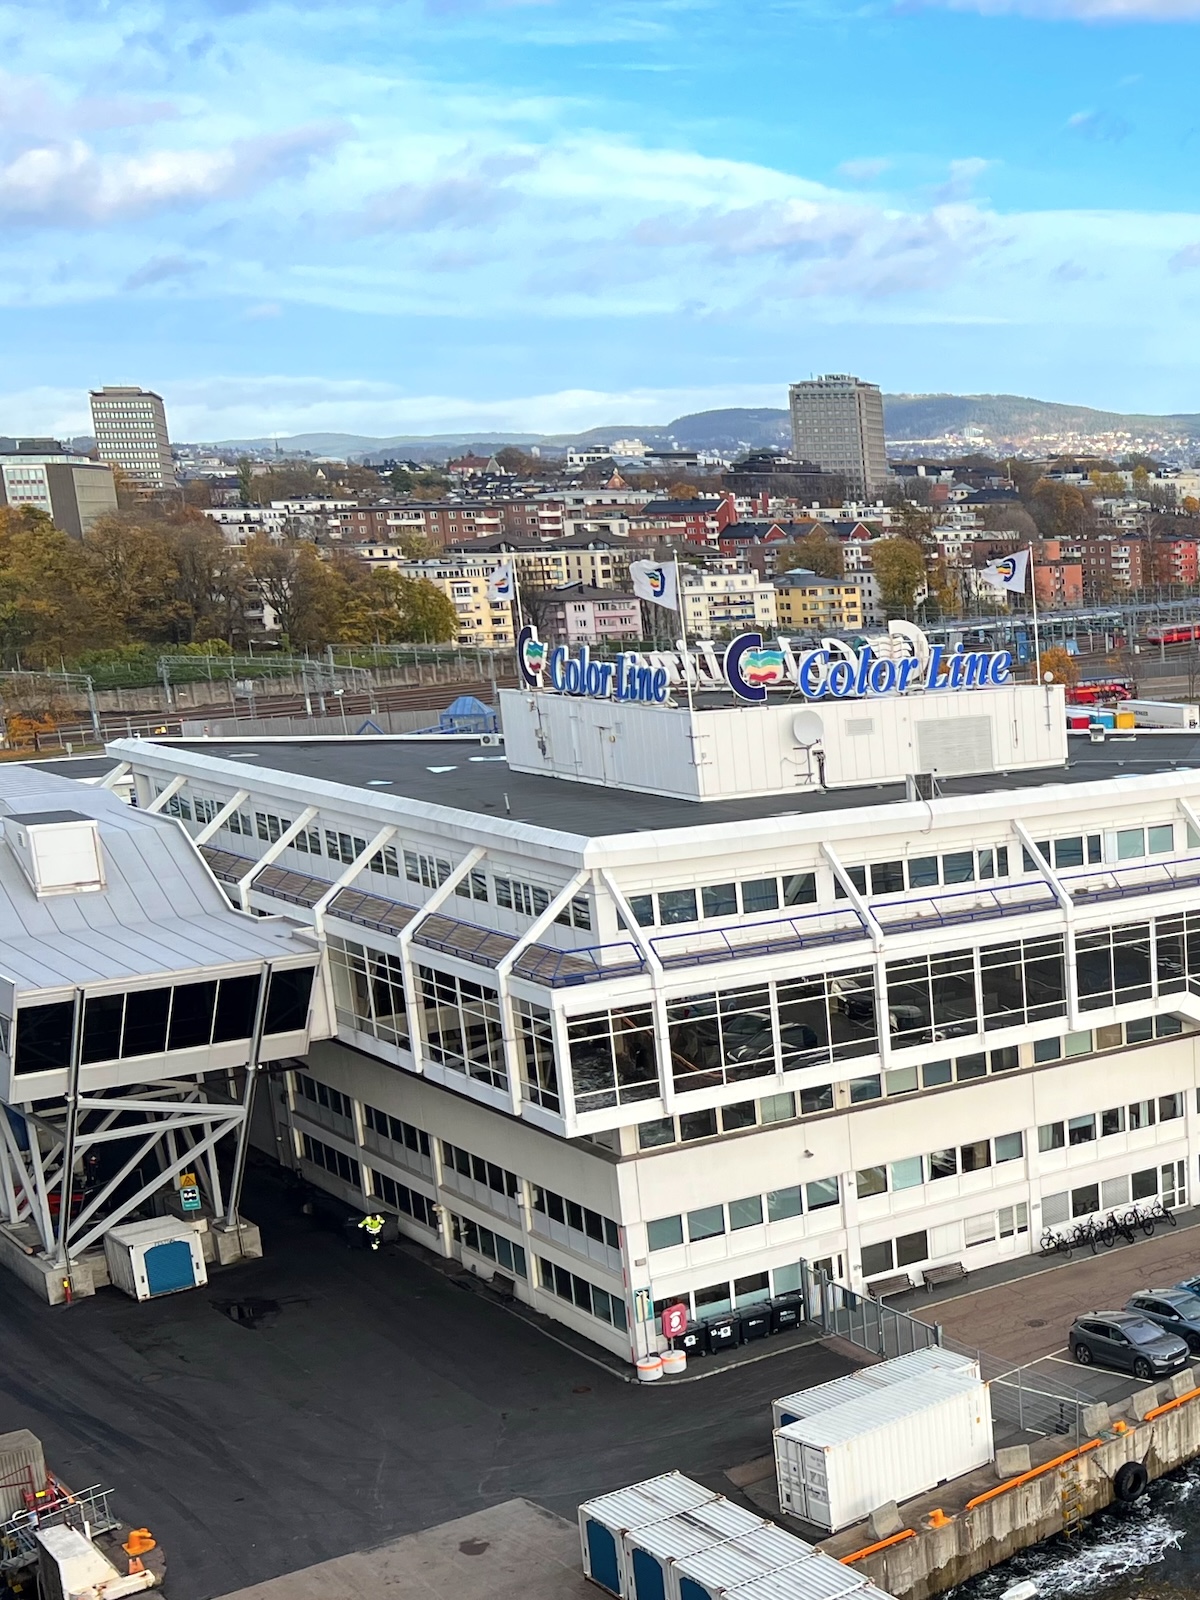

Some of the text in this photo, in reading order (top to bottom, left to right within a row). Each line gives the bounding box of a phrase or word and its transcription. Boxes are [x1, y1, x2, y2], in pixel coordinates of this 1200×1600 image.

[551, 645, 671, 704] Color Line
[798, 641, 1012, 698] Color Line
